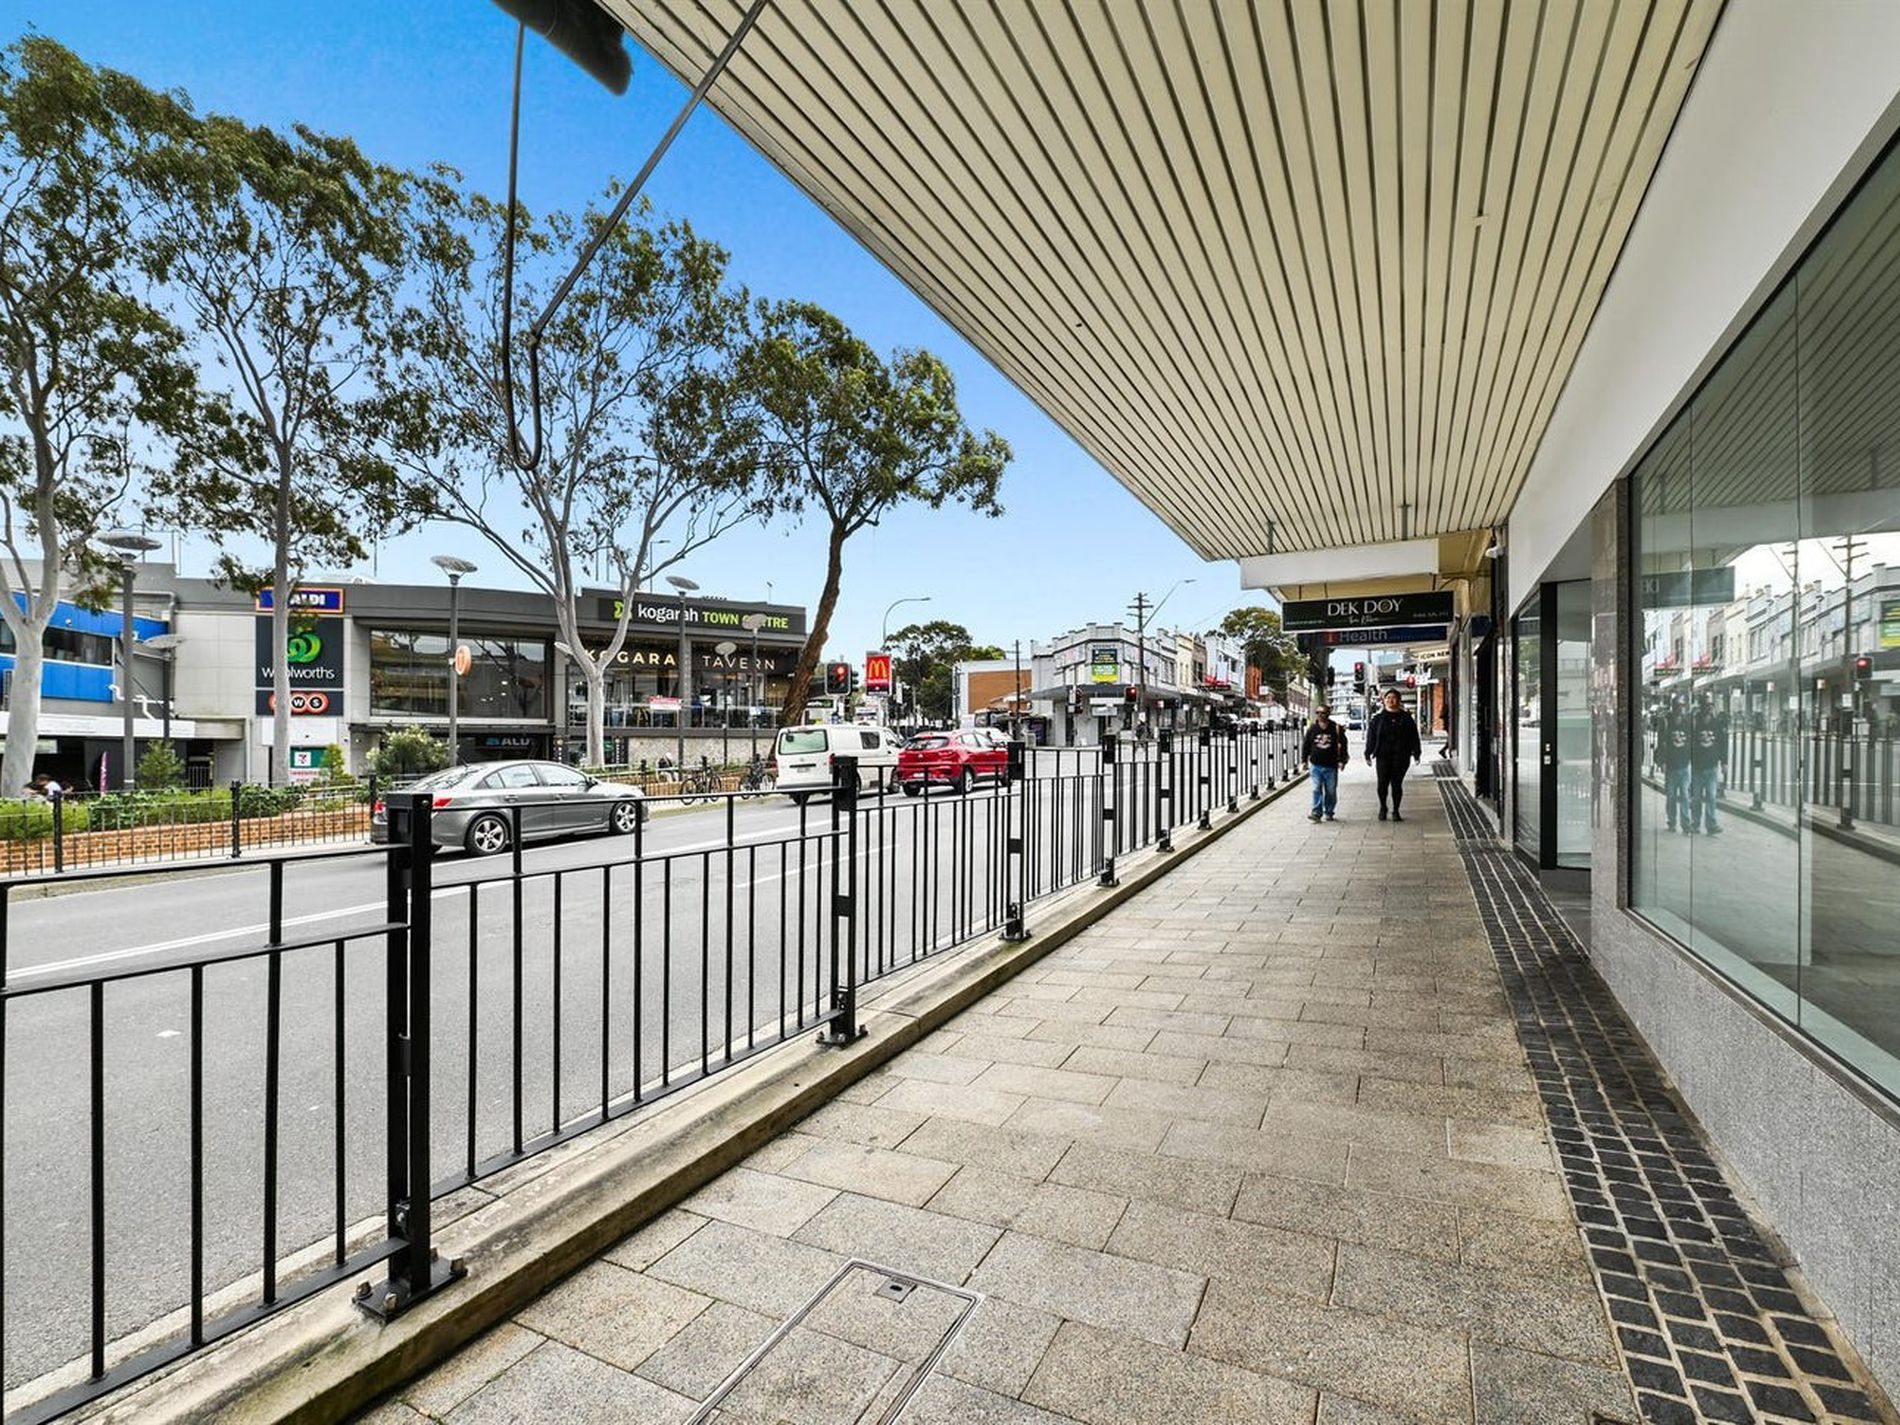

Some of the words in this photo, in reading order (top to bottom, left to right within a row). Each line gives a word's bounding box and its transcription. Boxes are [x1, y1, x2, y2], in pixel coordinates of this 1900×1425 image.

[290, 594, 326, 606] ALDI
[1327, 602, 1359, 617] DEK
[1363, 598, 1403, 614] DOY
[702, 611, 739, 625] TOWN
[1338, 629, 1388, 644] Health
